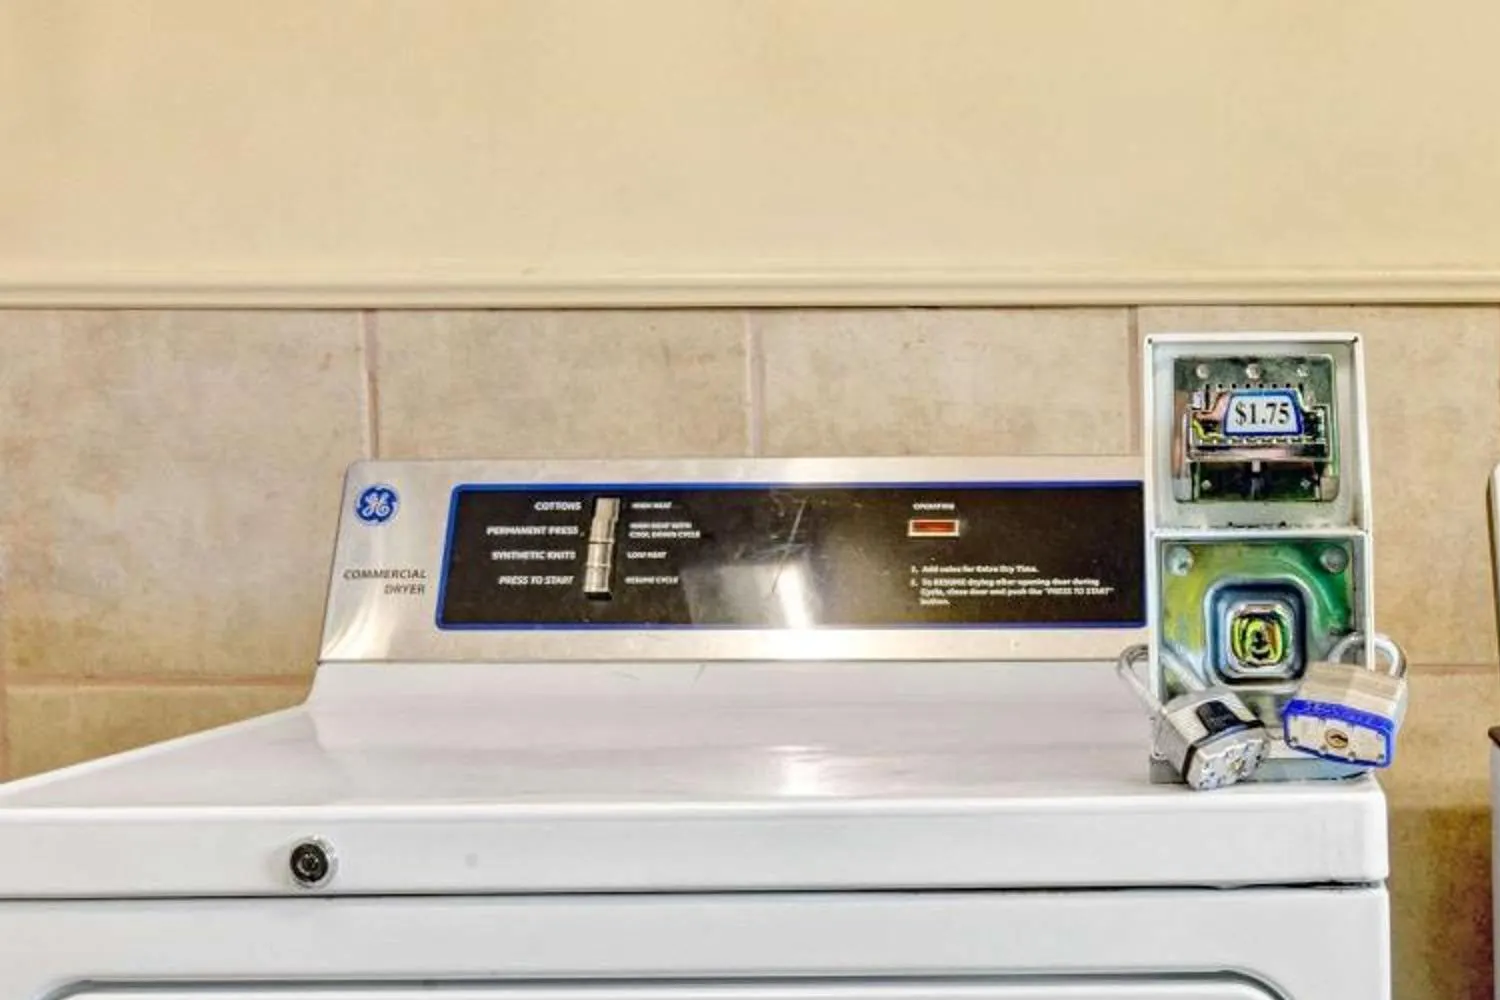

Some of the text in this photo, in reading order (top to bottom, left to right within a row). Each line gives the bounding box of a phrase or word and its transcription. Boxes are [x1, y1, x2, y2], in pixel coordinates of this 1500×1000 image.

[1235, 401, 1290, 426] $1.75
[534, 501, 582, 511] COTTONS
[486, 526, 579, 536] PERMANENT PRESS
[491, 551, 577, 560] SYNTHETIC KNITS
[343, 568, 427, 579] COMMERCIAL
[498, 575, 575, 584] PRESS TO START
[383, 583, 425, 595] DRYER
